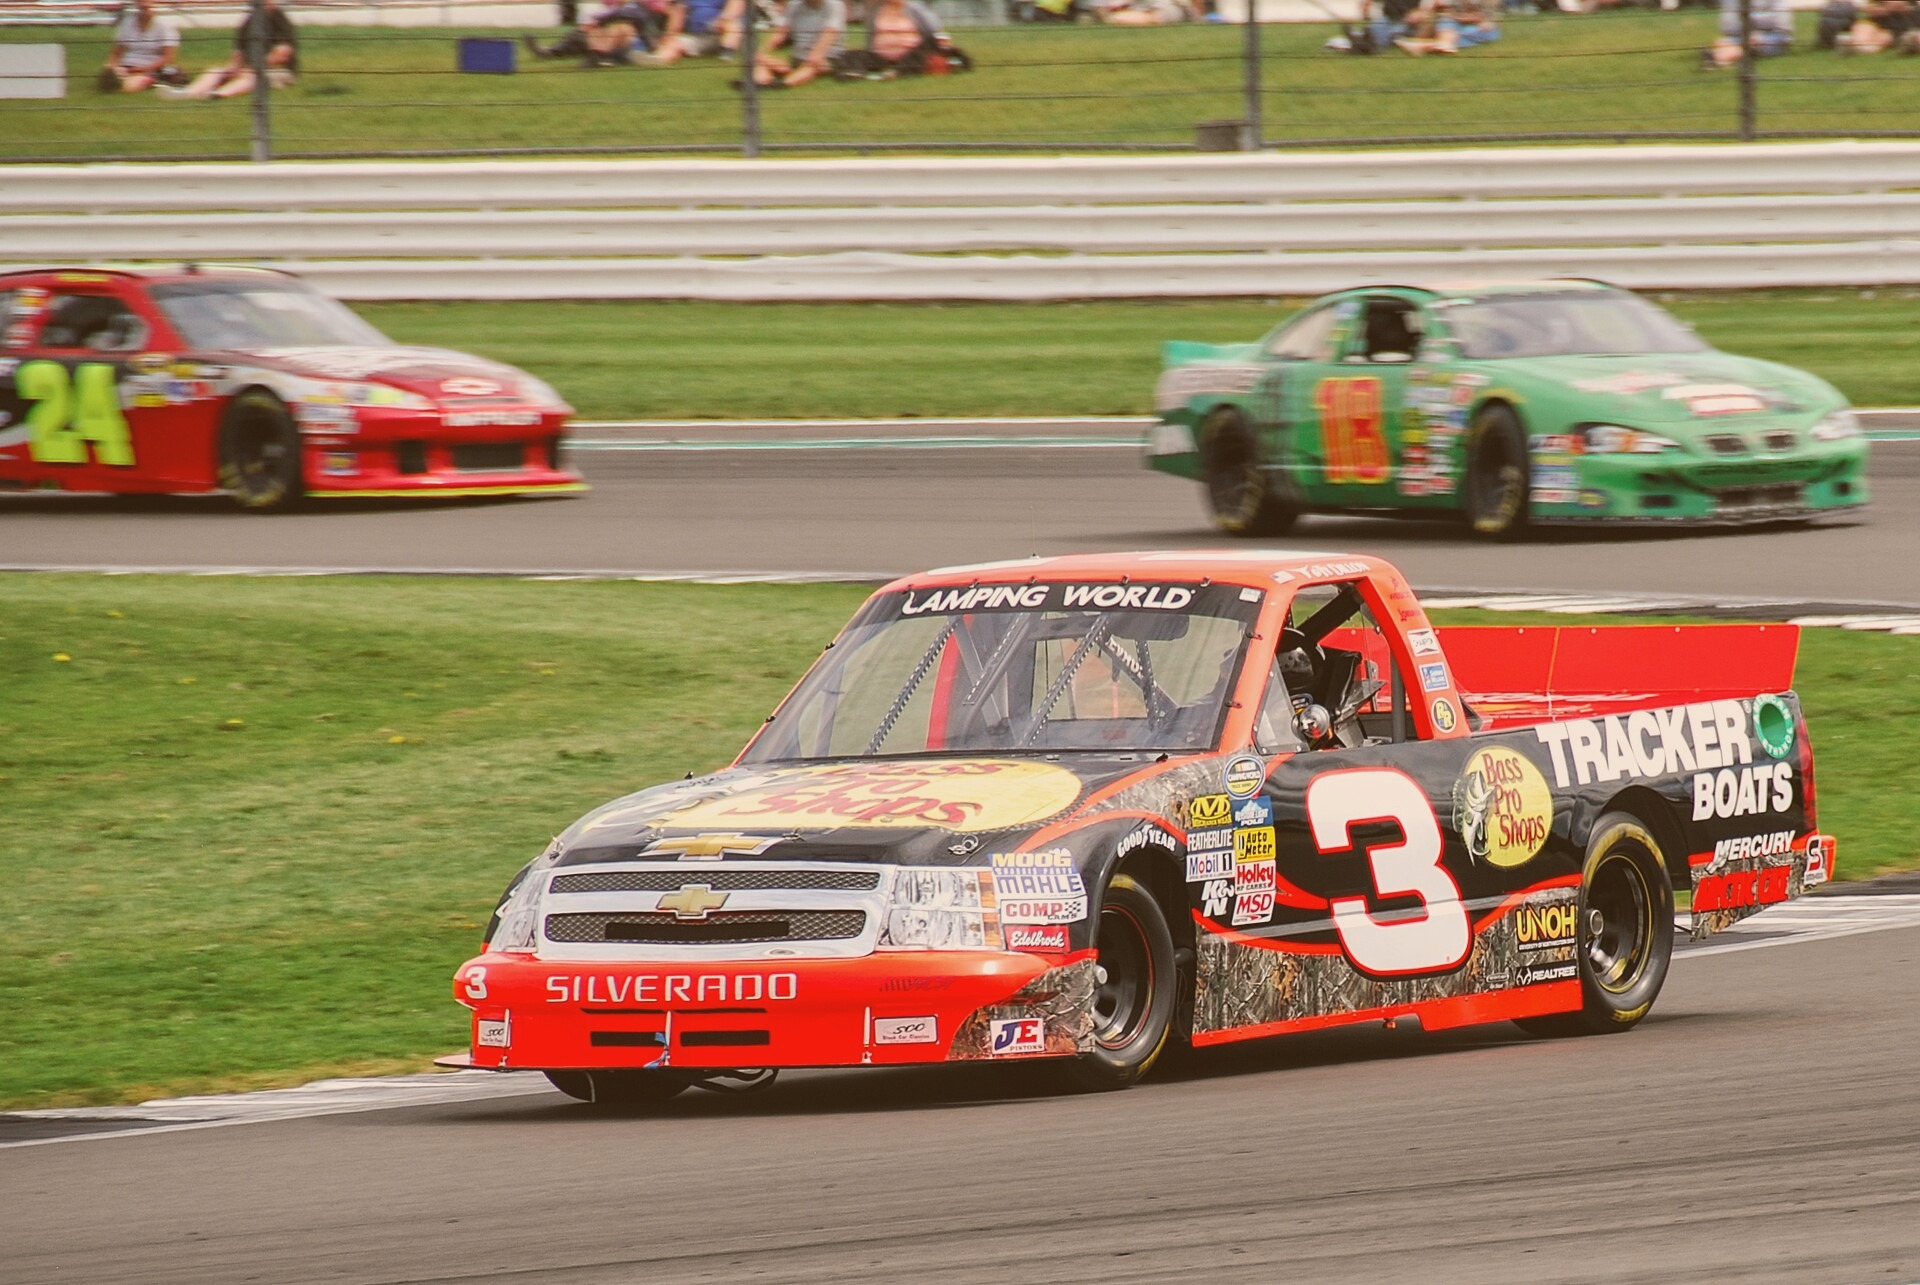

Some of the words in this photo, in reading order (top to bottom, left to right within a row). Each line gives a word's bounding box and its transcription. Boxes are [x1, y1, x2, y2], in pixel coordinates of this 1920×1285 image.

[14, 360, 136, 465] 24
[1312, 377, 1391, 483] 18
[1062, 586, 1192, 610] WORLD
[1535, 700, 1752, 789] TRACKER
[1482, 753, 1523, 785] Bass
[1493, 784, 1522, 816] Pro
[1692, 761, 1794, 821] BOATS
[1187, 829, 1233, 852] FEATHERLITE
[1247, 831, 1267, 844] Auto
[1499, 814, 1546, 852] Shops
[992, 850, 1072, 868] MOOG
[1246, 843, 1272, 855] Meter
[1710, 830, 1795, 864] MERCURY
[1189, 855, 1219, 876] Mobil
[1223, 853, 1232, 872] 1
[1237, 863, 1274, 888] Holley
[1306, 767, 1472, 975] 3
[996, 875, 1082, 894] MAHLE
[1006, 902, 1063, 917] COMP
[1047, 912, 1078, 920] CAMS
[1236, 893, 1272, 915] MSD
[1516, 904, 1576, 942] UNOH
[1010, 930, 1065, 948] Edelbrock
[465, 966, 488, 999] 3
[1532, 966, 1577, 982] REALTREE
[546, 973, 797, 1002] SILVERADO
[994, 1020, 1039, 1051] JE
[1010, 1044, 1043, 1052] PISTONS
